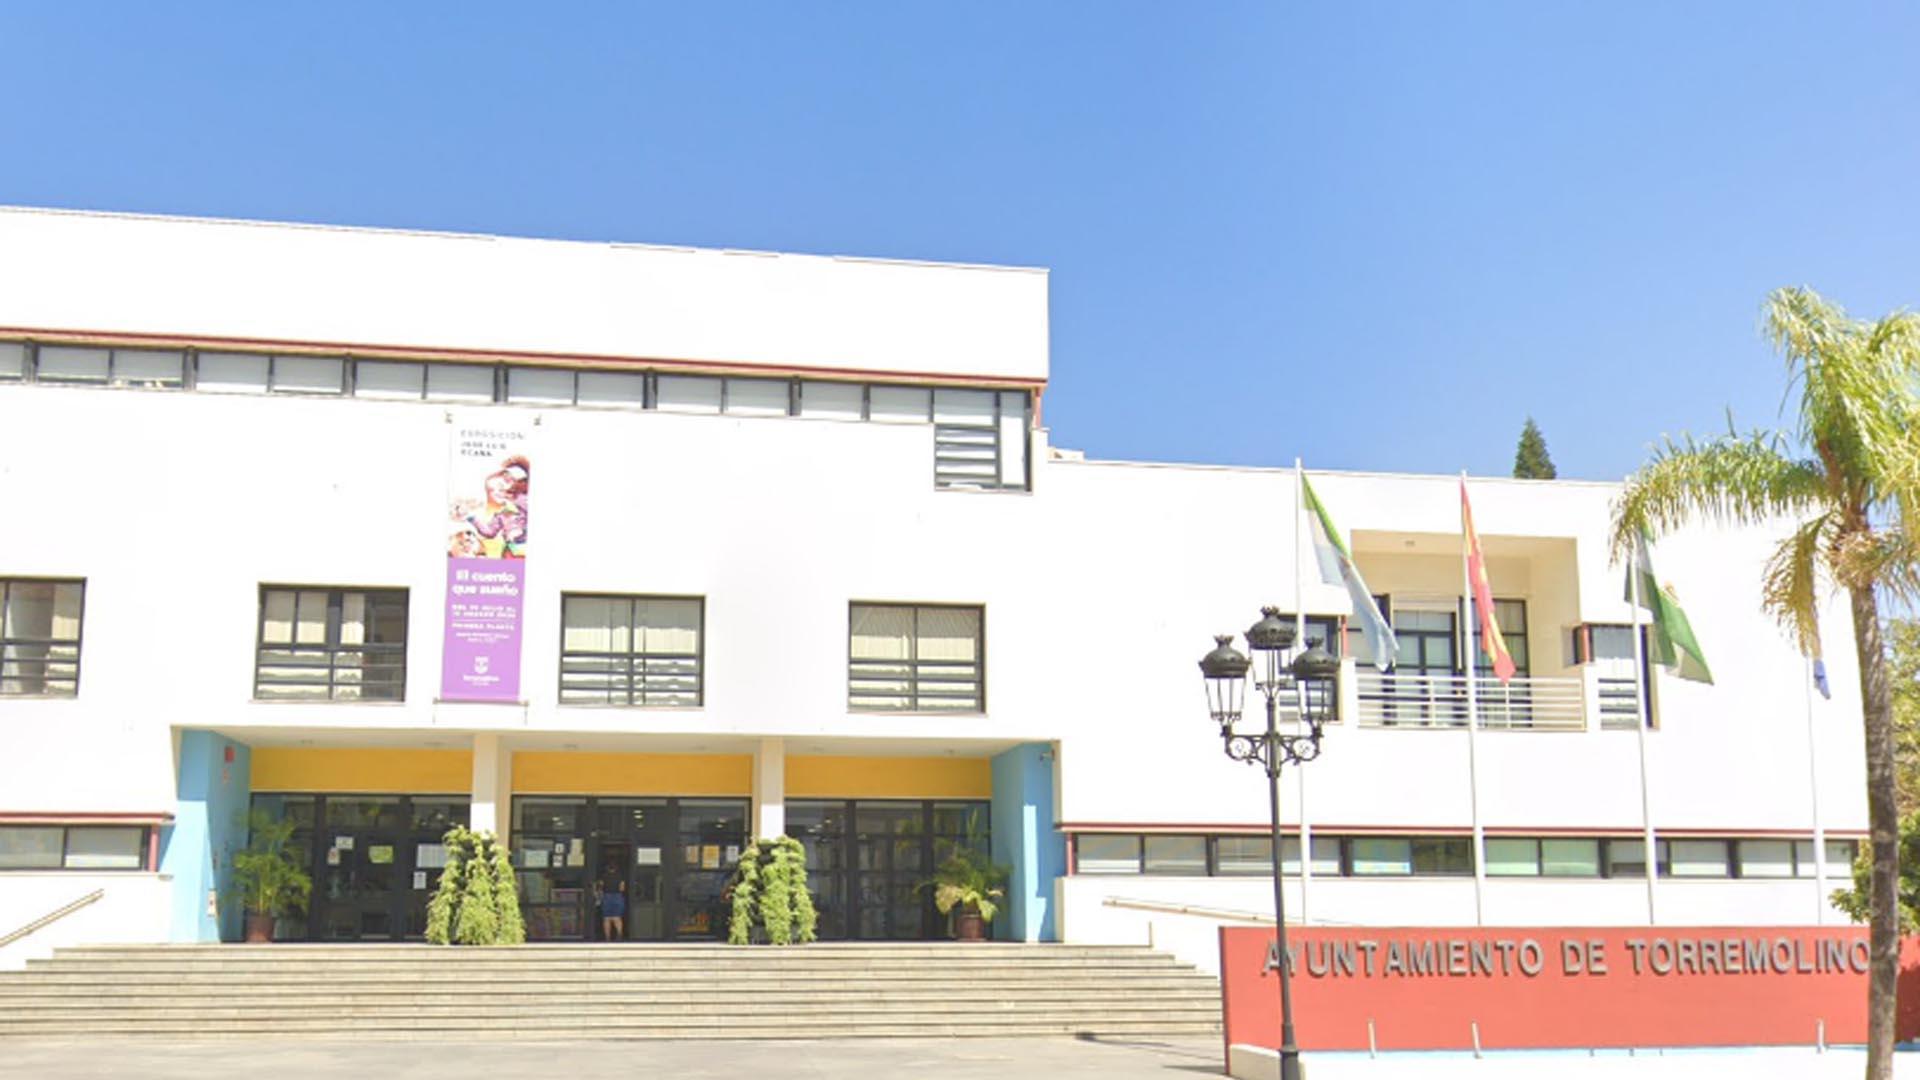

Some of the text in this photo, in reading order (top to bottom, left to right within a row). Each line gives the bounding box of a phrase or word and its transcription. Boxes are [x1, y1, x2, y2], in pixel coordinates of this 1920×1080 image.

[455, 569, 517, 583] El cuento
[451, 584, 519, 596] que sueño
[1261, 937, 1870, 977] AYUNTAMIENTO DE TORREMOLINO
